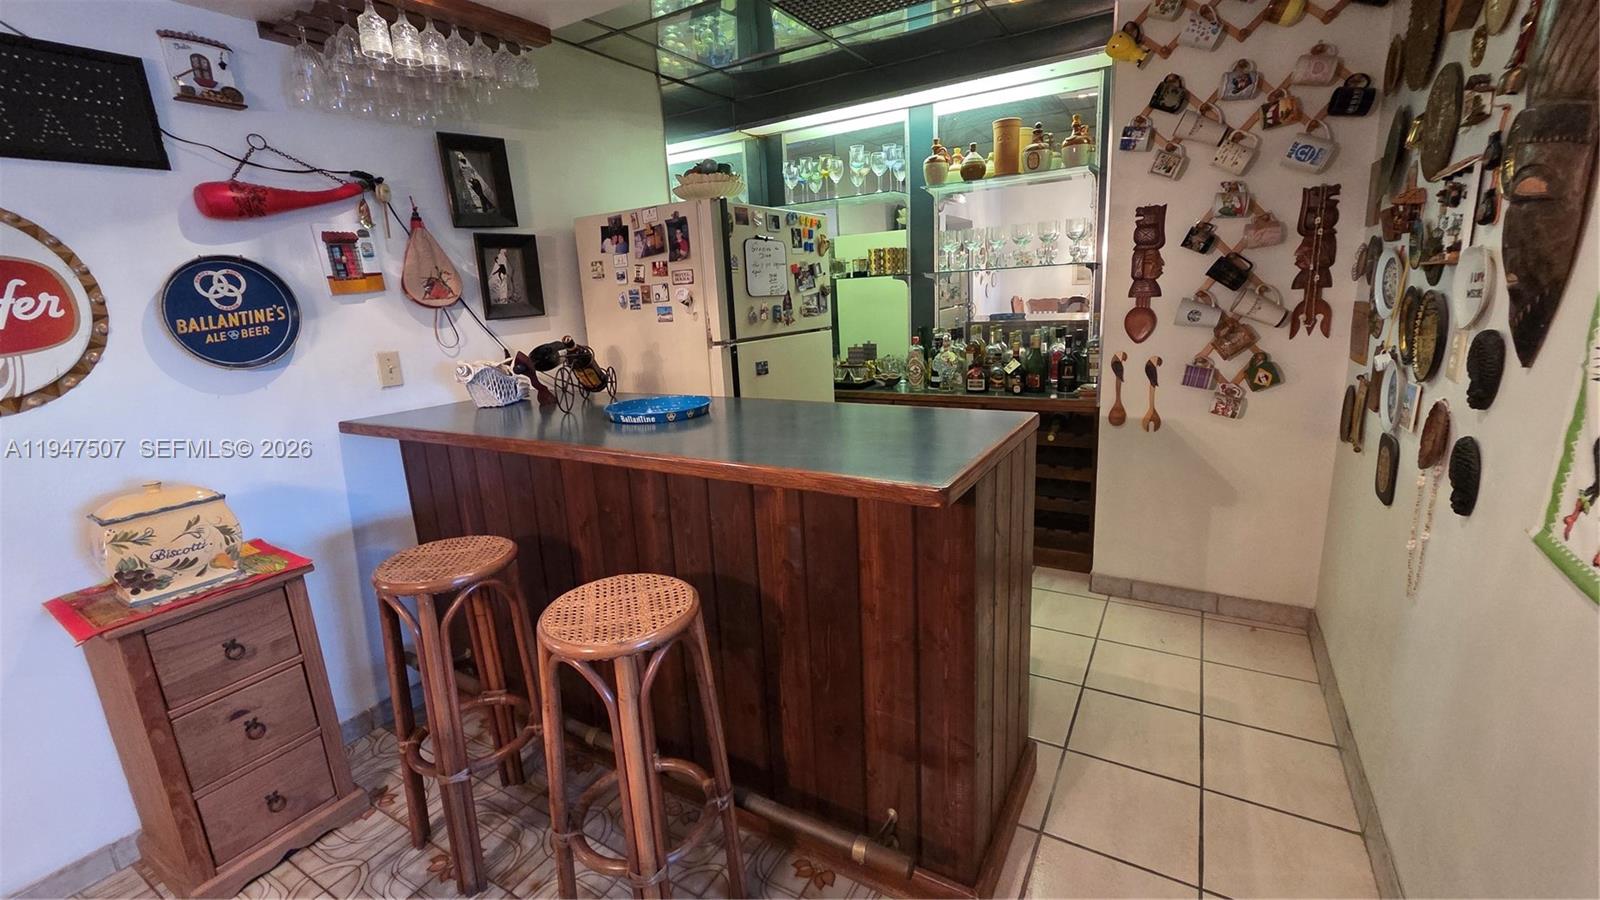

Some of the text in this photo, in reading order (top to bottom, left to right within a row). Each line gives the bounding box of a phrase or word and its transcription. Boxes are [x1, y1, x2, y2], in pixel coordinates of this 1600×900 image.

[176, 304, 286, 334] BALLANTINE'S
[205, 325, 271, 344] ALE BEER
